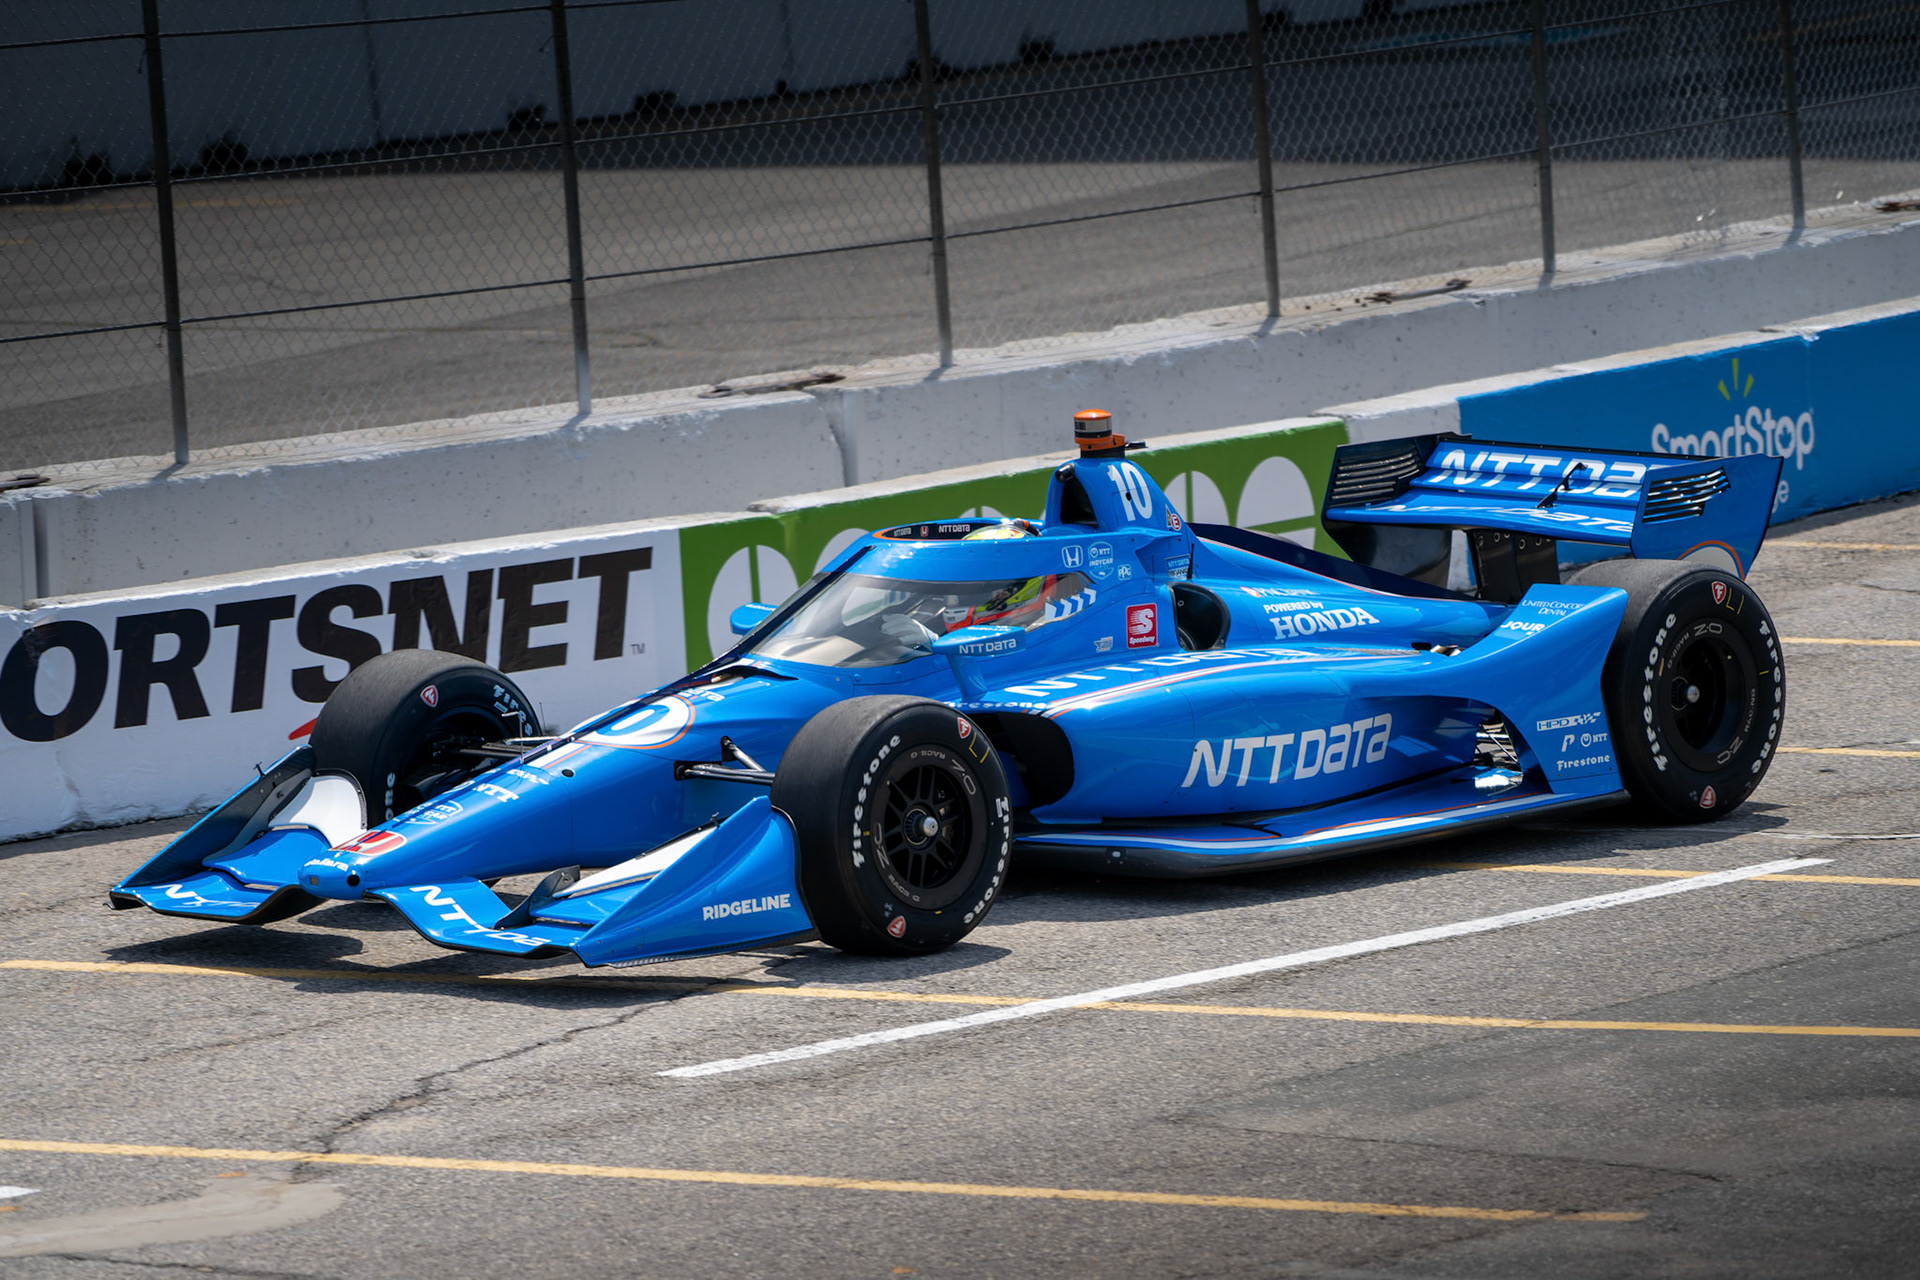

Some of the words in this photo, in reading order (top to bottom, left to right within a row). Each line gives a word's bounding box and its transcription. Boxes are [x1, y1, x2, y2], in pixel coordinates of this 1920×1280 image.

[1107, 462, 1153, 522] 10
[938, 524, 952, 533] NTT
[1089, 557, 1114, 567] INDYCAR
[1263, 602, 1310, 614] POWERED
[1311, 601, 1324, 609] by
[1537, 607, 1567, 616] DENTAL
[1269, 606, 1381, 641] HONDA
[0, 545, 653, 743] ORTSNET
[959, 643, 984, 654] NTT
[1129, 636, 1156, 646] Speedway
[1642, 612, 1677, 772] Firestone
[1751, 619, 1782, 774] Firestone
[1537, 717, 1571, 731] HPD
[1592, 733, 1609, 743] NTT
[1181, 732, 1296, 788] NTT
[1555, 754, 1611, 772] Firestone
[852, 734, 901, 869] Firestone
[963, 796, 1010, 925] Firestone
[410, 885, 526, 935] NTT
[702, 893, 791, 921] RIDGELINE
